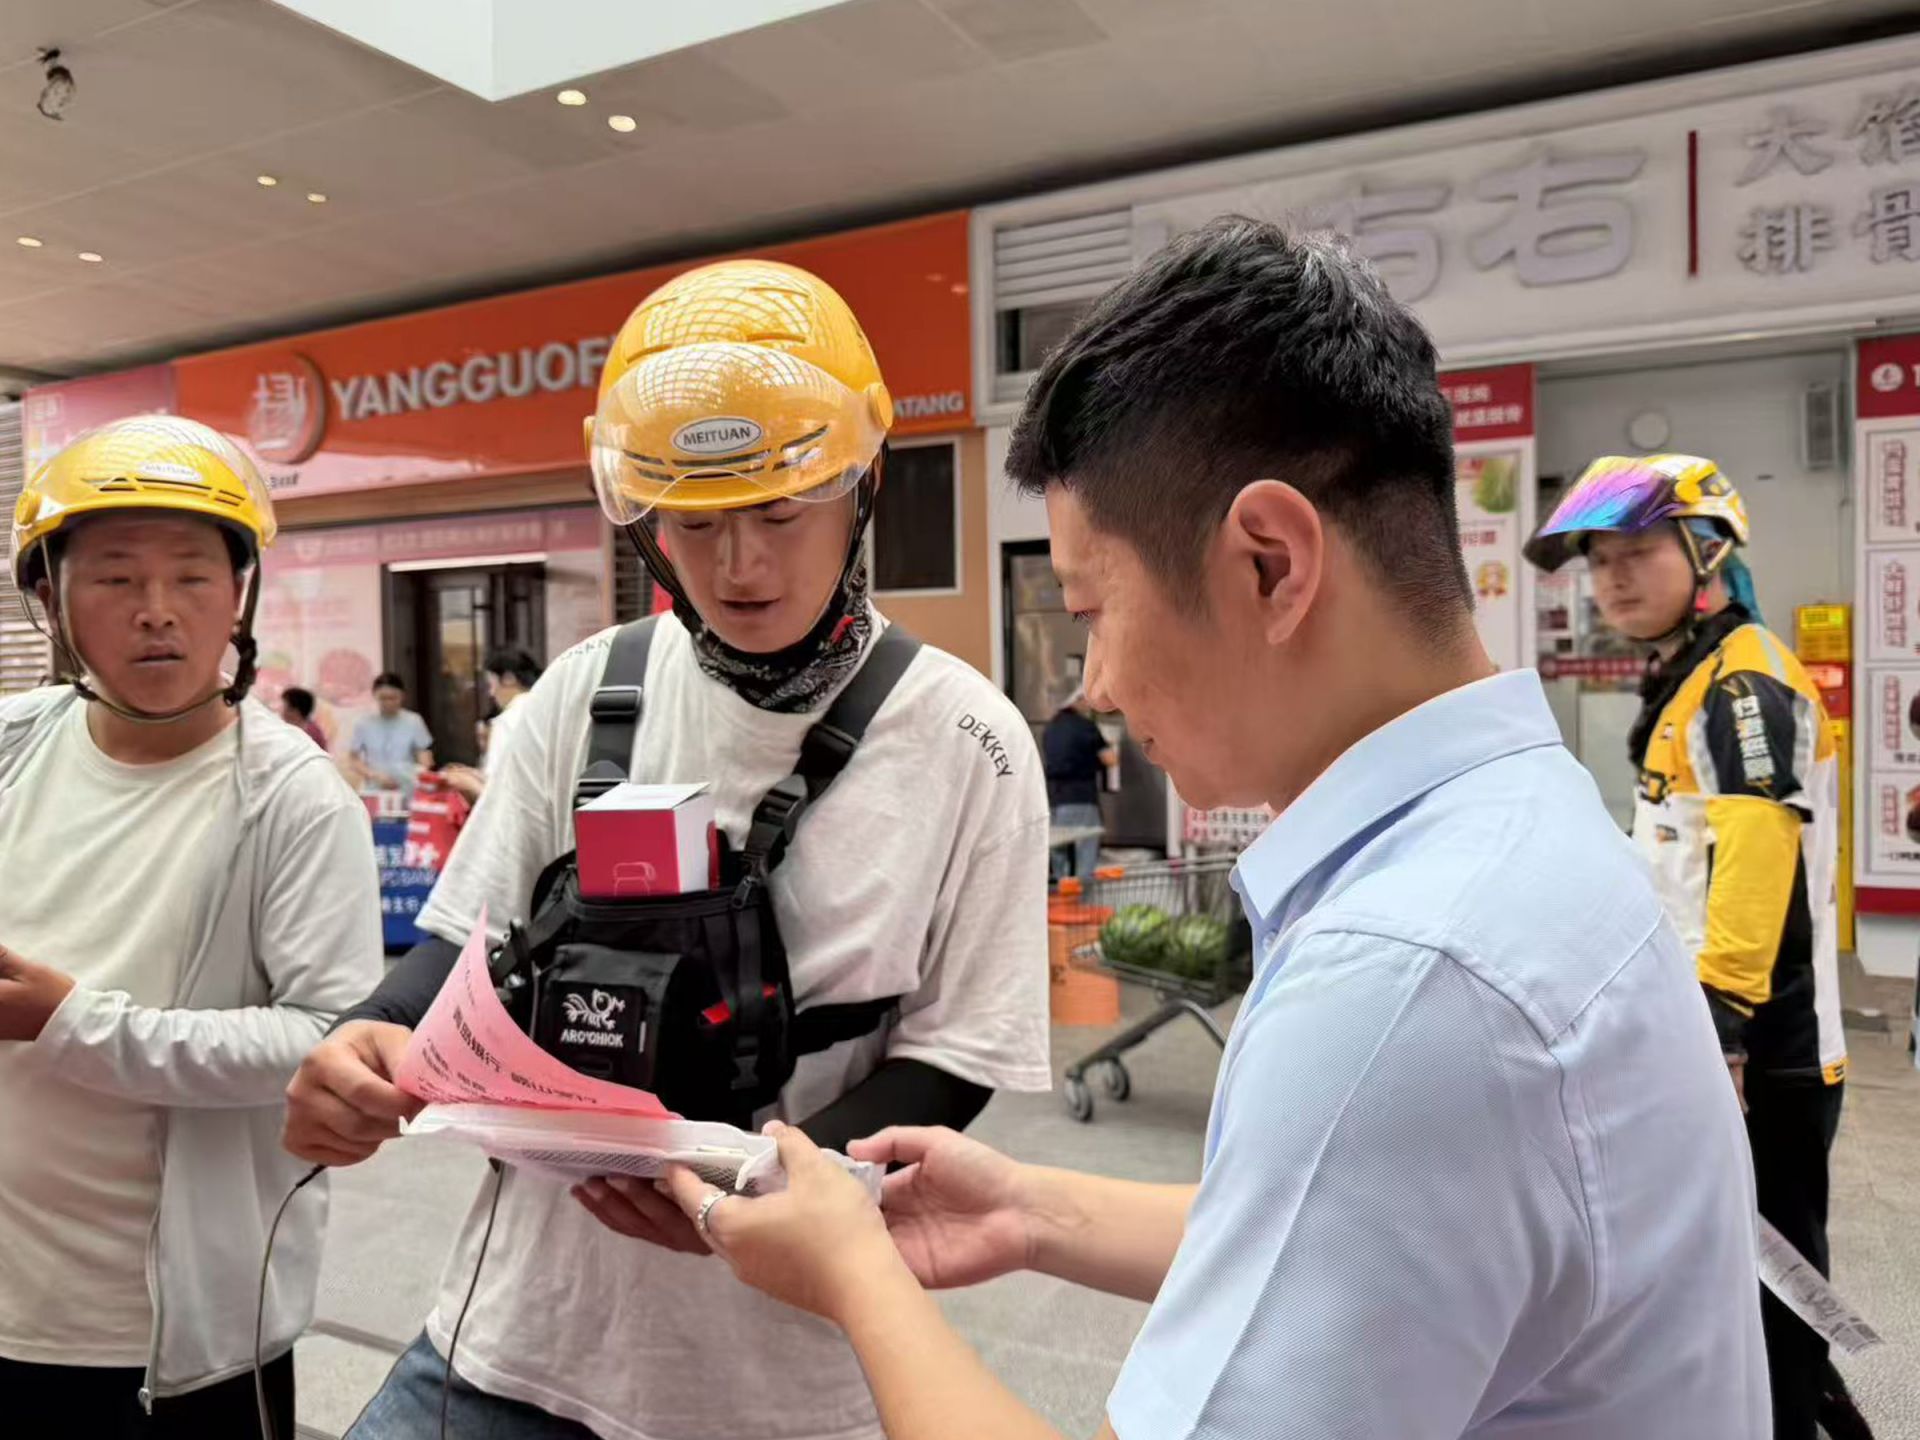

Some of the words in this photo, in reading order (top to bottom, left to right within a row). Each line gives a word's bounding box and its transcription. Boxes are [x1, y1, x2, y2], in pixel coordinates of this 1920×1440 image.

[1736, 180, 1920, 275] 排骨
[331, 336, 614, 421] YANGGUOF
[895, 391, 964, 418] ATANG
[683, 426, 751, 446] MEITUAN
[957, 713, 1014, 778] DEKKEY
